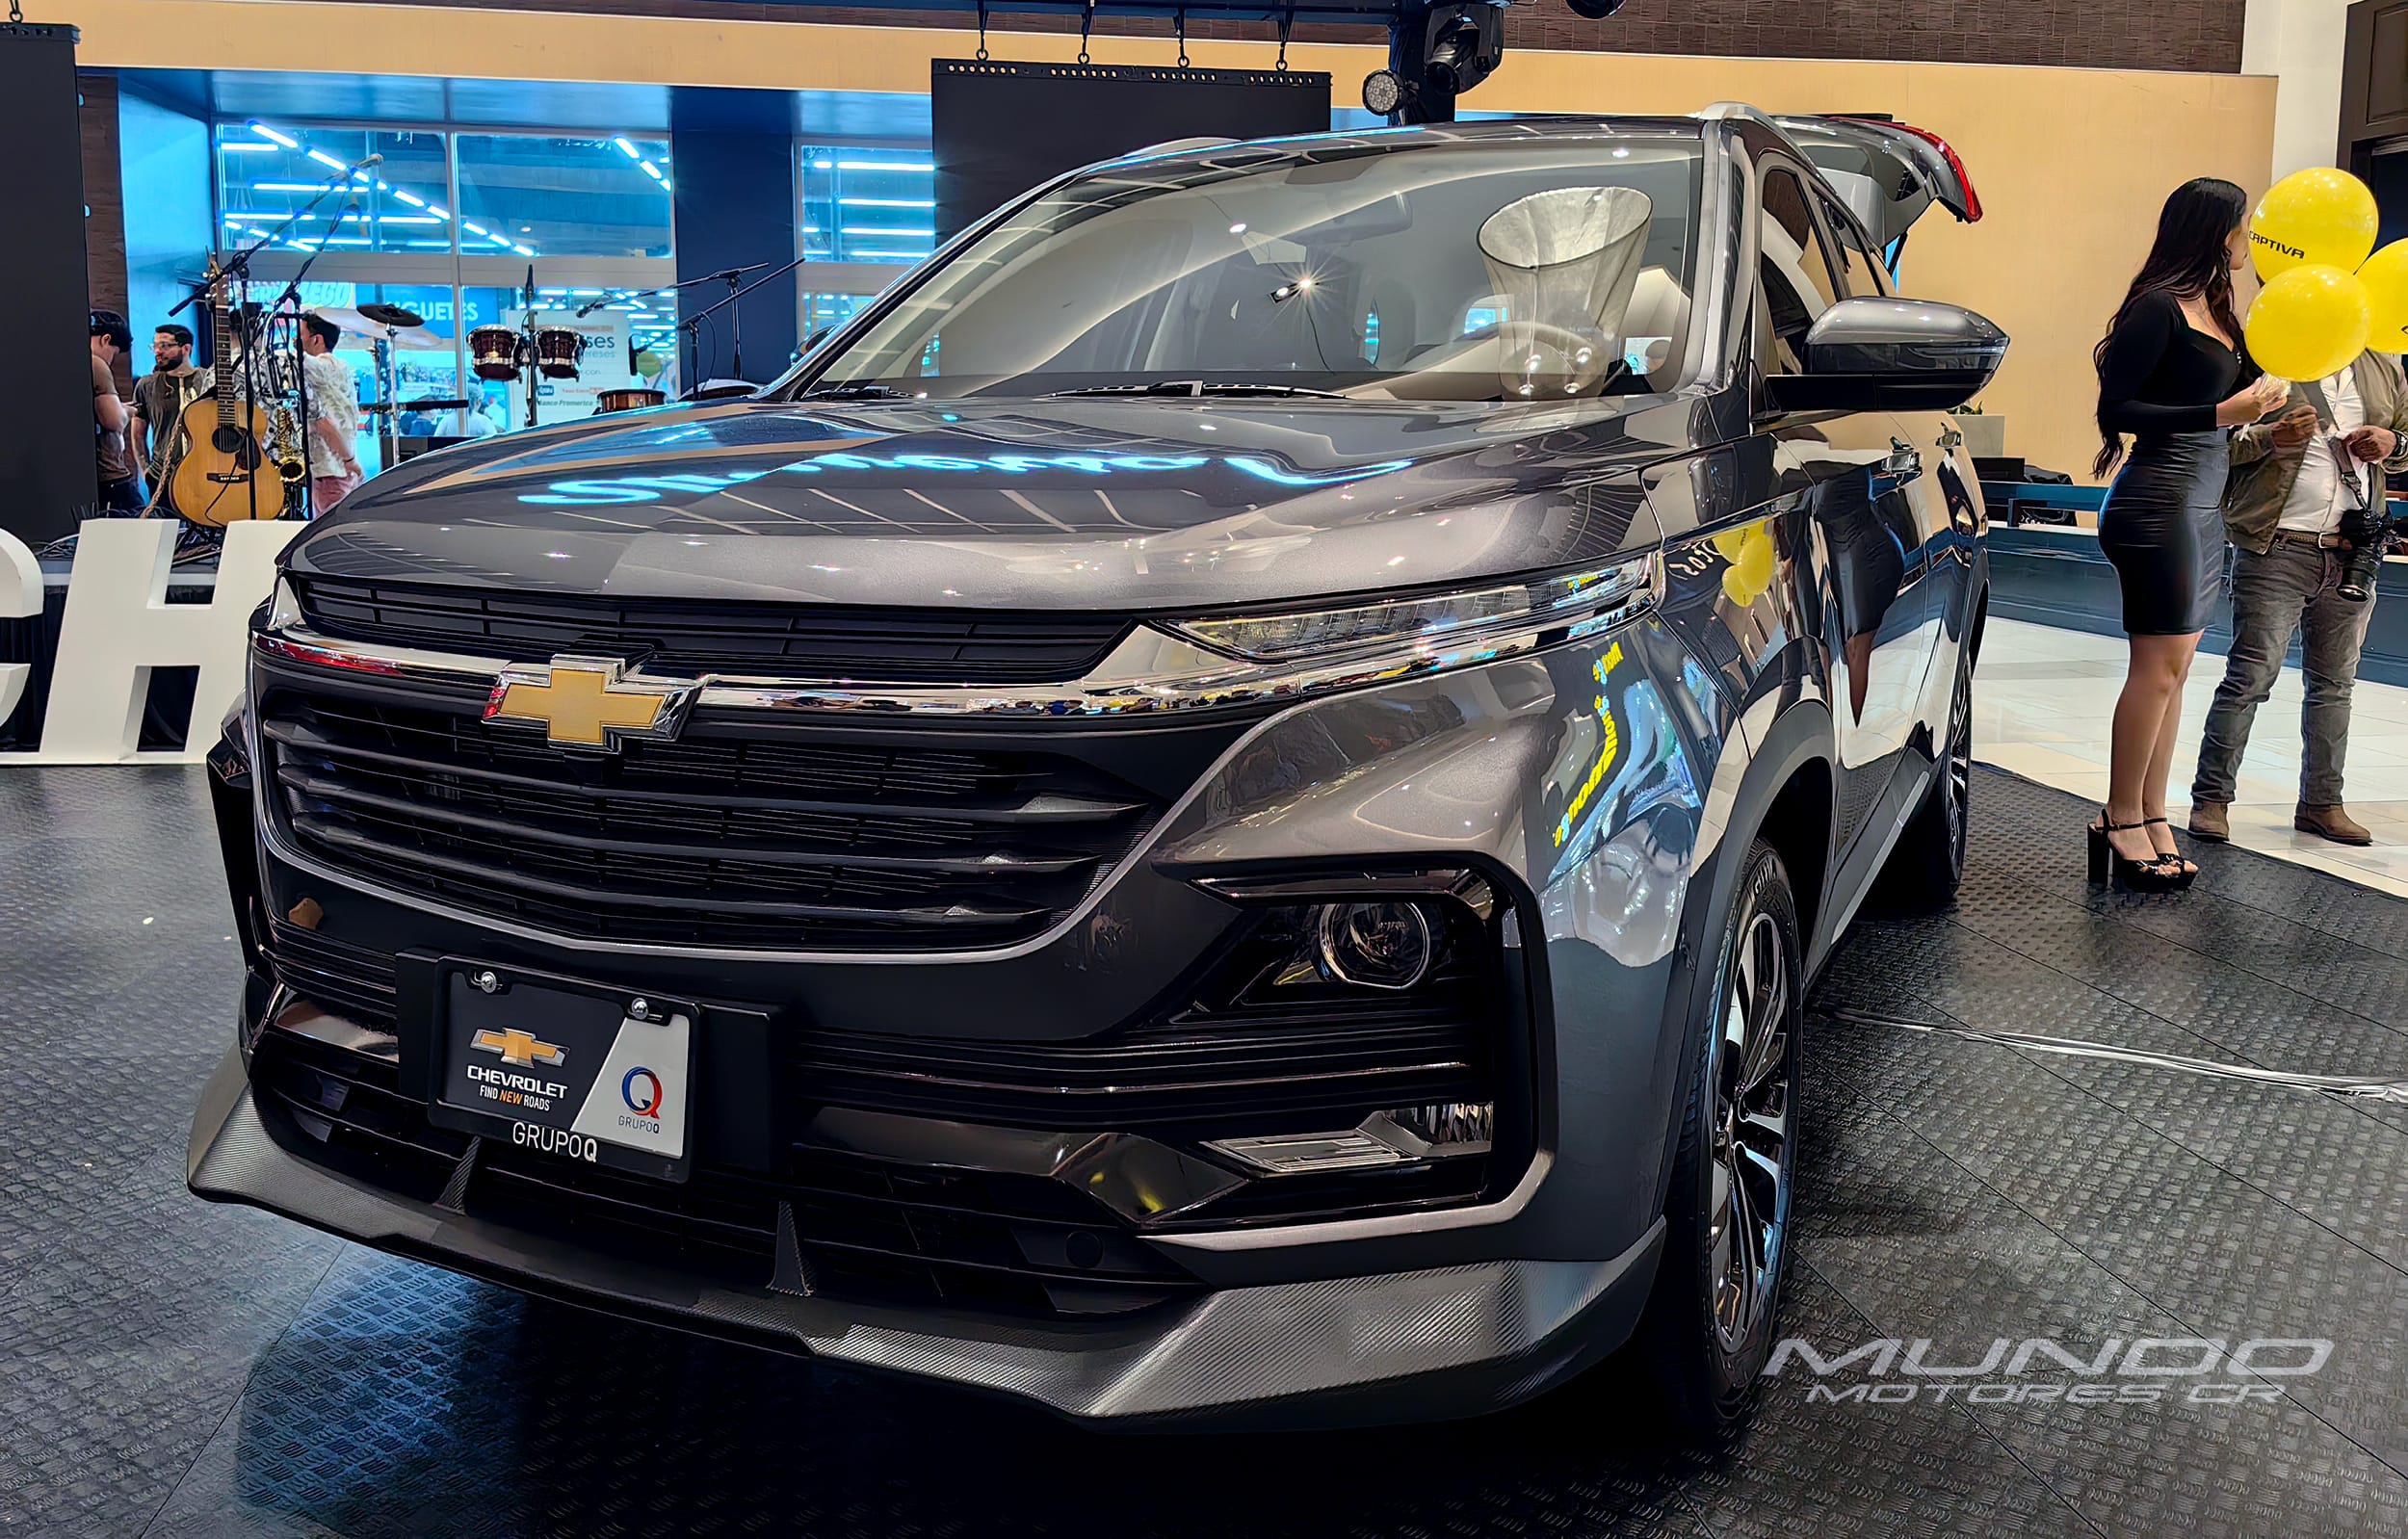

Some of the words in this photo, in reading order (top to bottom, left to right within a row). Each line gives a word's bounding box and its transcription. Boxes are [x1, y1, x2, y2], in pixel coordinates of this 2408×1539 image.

[2248, 230, 2305, 259] CAPTIVA
[467, 1064, 567, 1099] CHEVROLET
[480, 1084, 499, 1100] FIND
[499, 1089, 524, 1106] NEW
[524, 1095, 551, 1111] ROADS
[620, 1066, 663, 1119] Q
